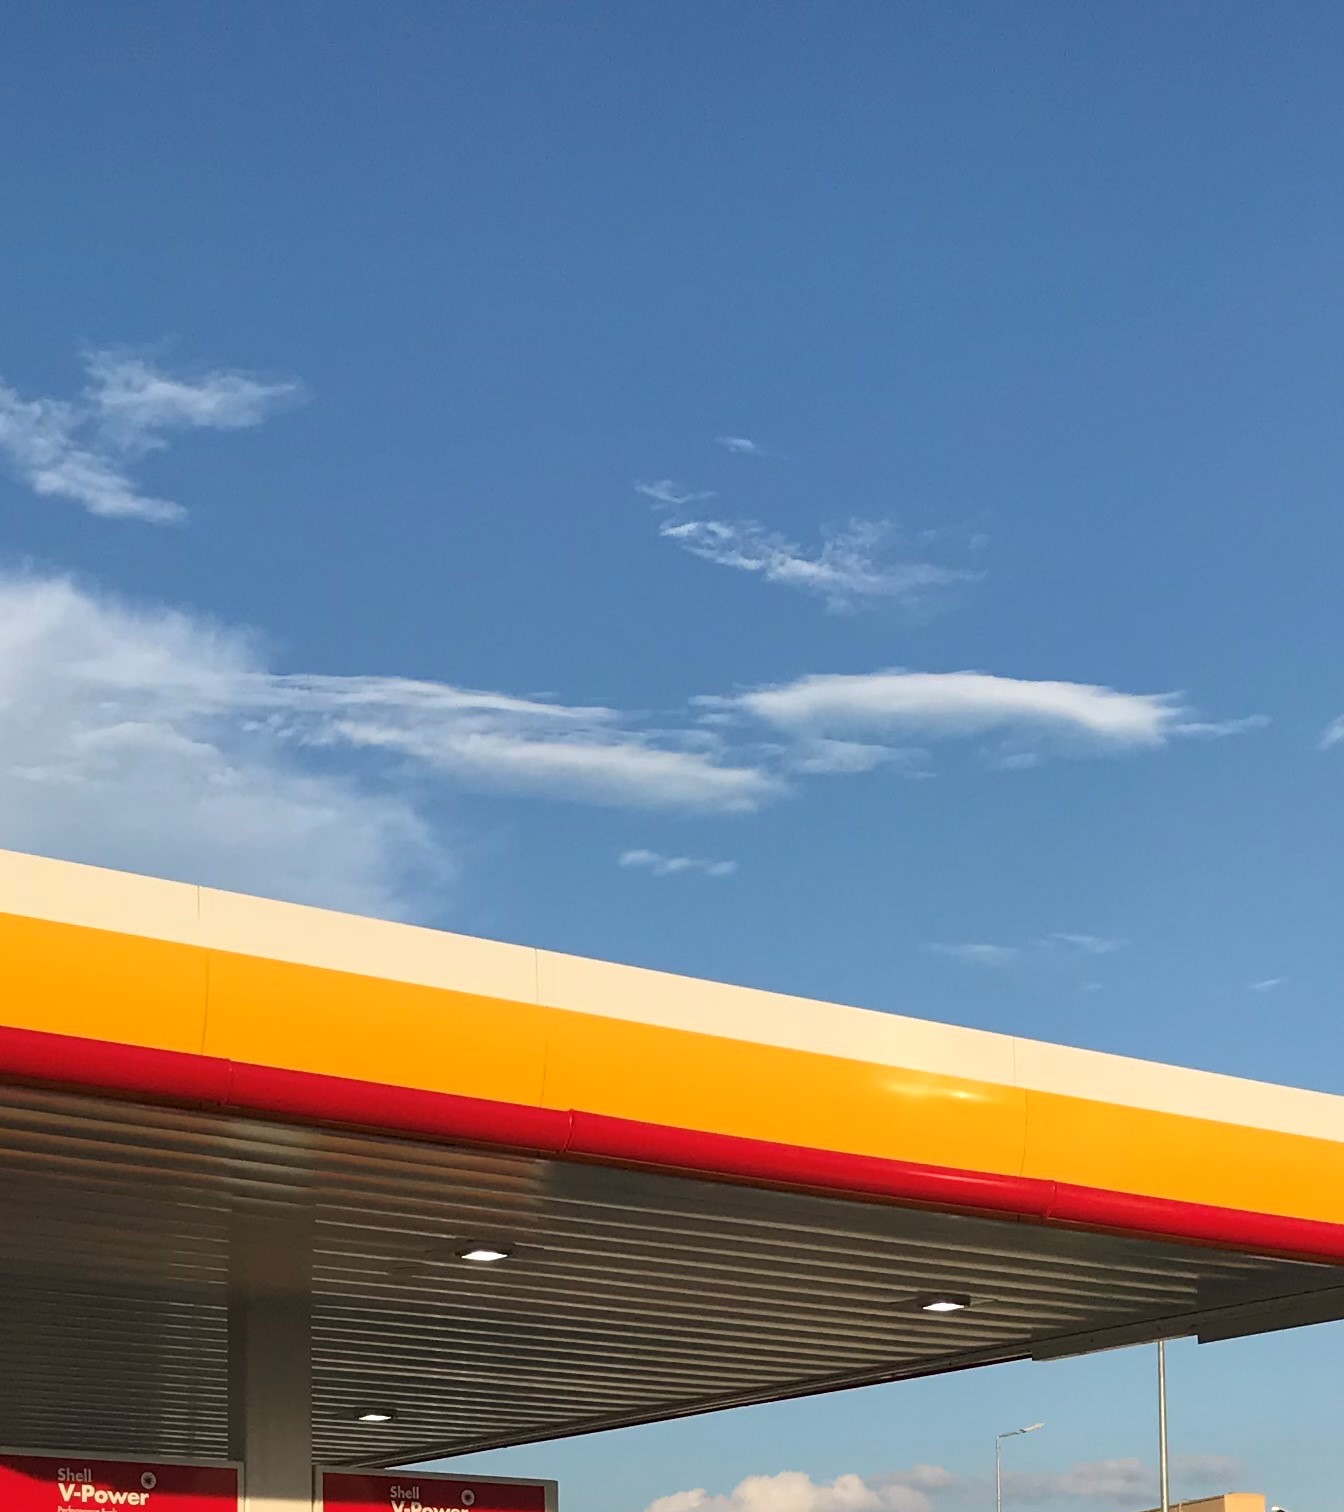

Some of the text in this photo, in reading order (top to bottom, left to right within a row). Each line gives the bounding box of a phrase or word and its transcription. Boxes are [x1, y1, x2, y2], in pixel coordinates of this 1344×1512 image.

[57, 1467, 92, 1483] Shell
[57, 1483, 149, 1506] V-Power
[390, 1485, 420, 1499] Shell
